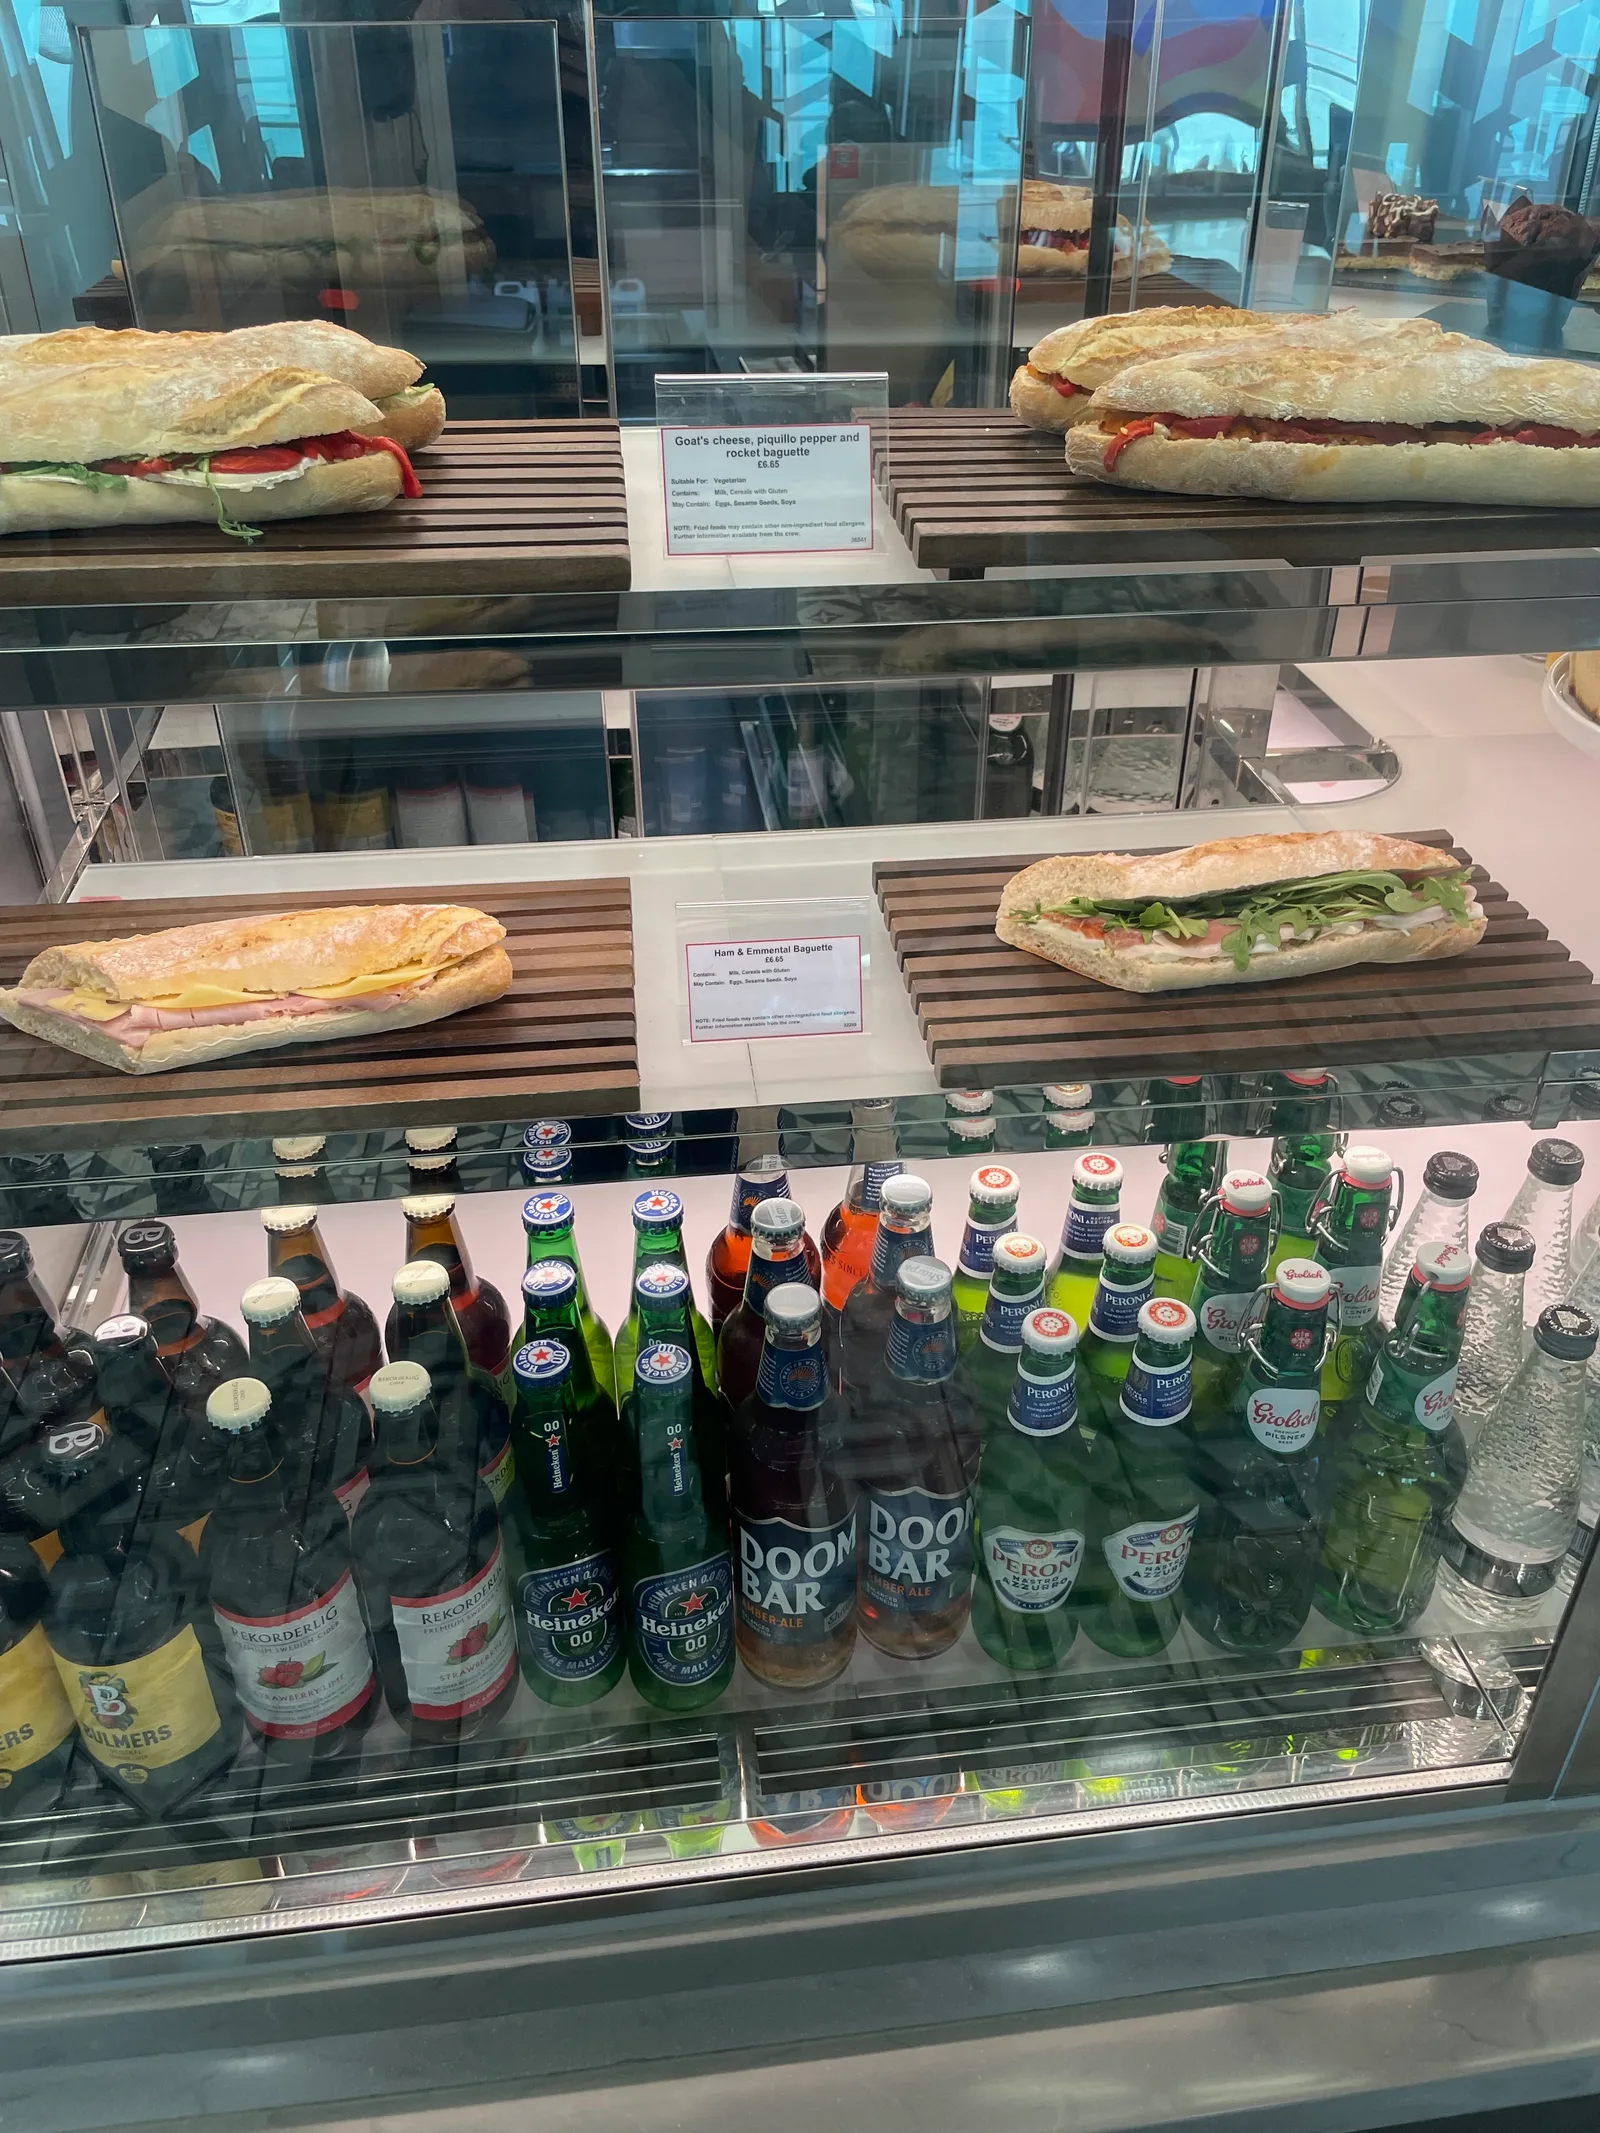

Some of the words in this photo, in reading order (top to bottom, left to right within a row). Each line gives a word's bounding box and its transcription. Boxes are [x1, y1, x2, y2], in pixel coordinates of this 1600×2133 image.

[675, 436, 709, 446] Goat's
[713, 434, 754, 446] cheese,
[757, 433, 797, 447] piquillo
[800, 433, 836, 447] pepper
[840, 432, 860, 443] and
[726, 448, 760, 458] rocket
[763, 446, 810, 458] baguette
[757, 460, 780, 469] £6.65
[713, 477, 746, 485] Vegetarian
[759, 499, 780, 507] Seeds,
[714, 949, 735, 957] Ham
[737, 948, 744, 956] &
[747, 946, 791, 956] Emmental
[794, 944, 833, 955] Baguette
[1229, 1178, 1265, 1190] Grolsch
[651, 1190, 679, 1214] Heineken
[976, 1234, 995, 1245] PER
[1283, 1269, 1323, 1280] Grolsch
[1105, 1292, 1146, 1306] PERONI
[1001, 1300, 1041, 1317] PERONI
[516, 1339, 547, 1373] Heineken
[641, 1357, 686, 1377] Heineken
[1027, 1383, 1070, 1400] PERONI
[1253, 1399, 1319, 1429] Grolsch
[544, 1420, 559, 1432] 0.0
[667, 1424, 682, 1436] 0.0
[1265, 1431, 1306, 1440] PILSNER
[553, 1449, 563, 1489] Heineken
[674, 1452, 683, 1492] Heineken
[868, 1534, 952, 1584] BAR
[992, 1545, 1079, 1578] PERONI
[1002, 1577, 1068, 1591] AZZURRO
[1012, 1575, 1059, 1584] NASTRO
[531, 1574, 580, 1606] HEINEKEN
[647, 1579, 698, 1611] HEINEKEN
[741, 1562, 826, 1615] BAR
[908, 1586, 932, 1597] ALE
[1012, 1599, 1056, 1609] ITALIANA
[231, 1605, 338, 1643] REKORDERLIG
[424, 1618, 465, 1635] PREMIUM
[780, 1617, 803, 1629] ALE
[275, 1637, 314, 1654] SWEDISH
[317, 1621, 340, 1640] CIDER
[569, 1630, 593, 1647] 0.0
[684, 1634, 708, 1653] 0.0
[538, 1646, 562, 1667] PURE
[566, 1655, 596, 1670] MALT
[652, 1652, 678, 1672] PURE
[680, 1659, 709, 1675] MALT
[83, 1724, 172, 1749] BULMERS
